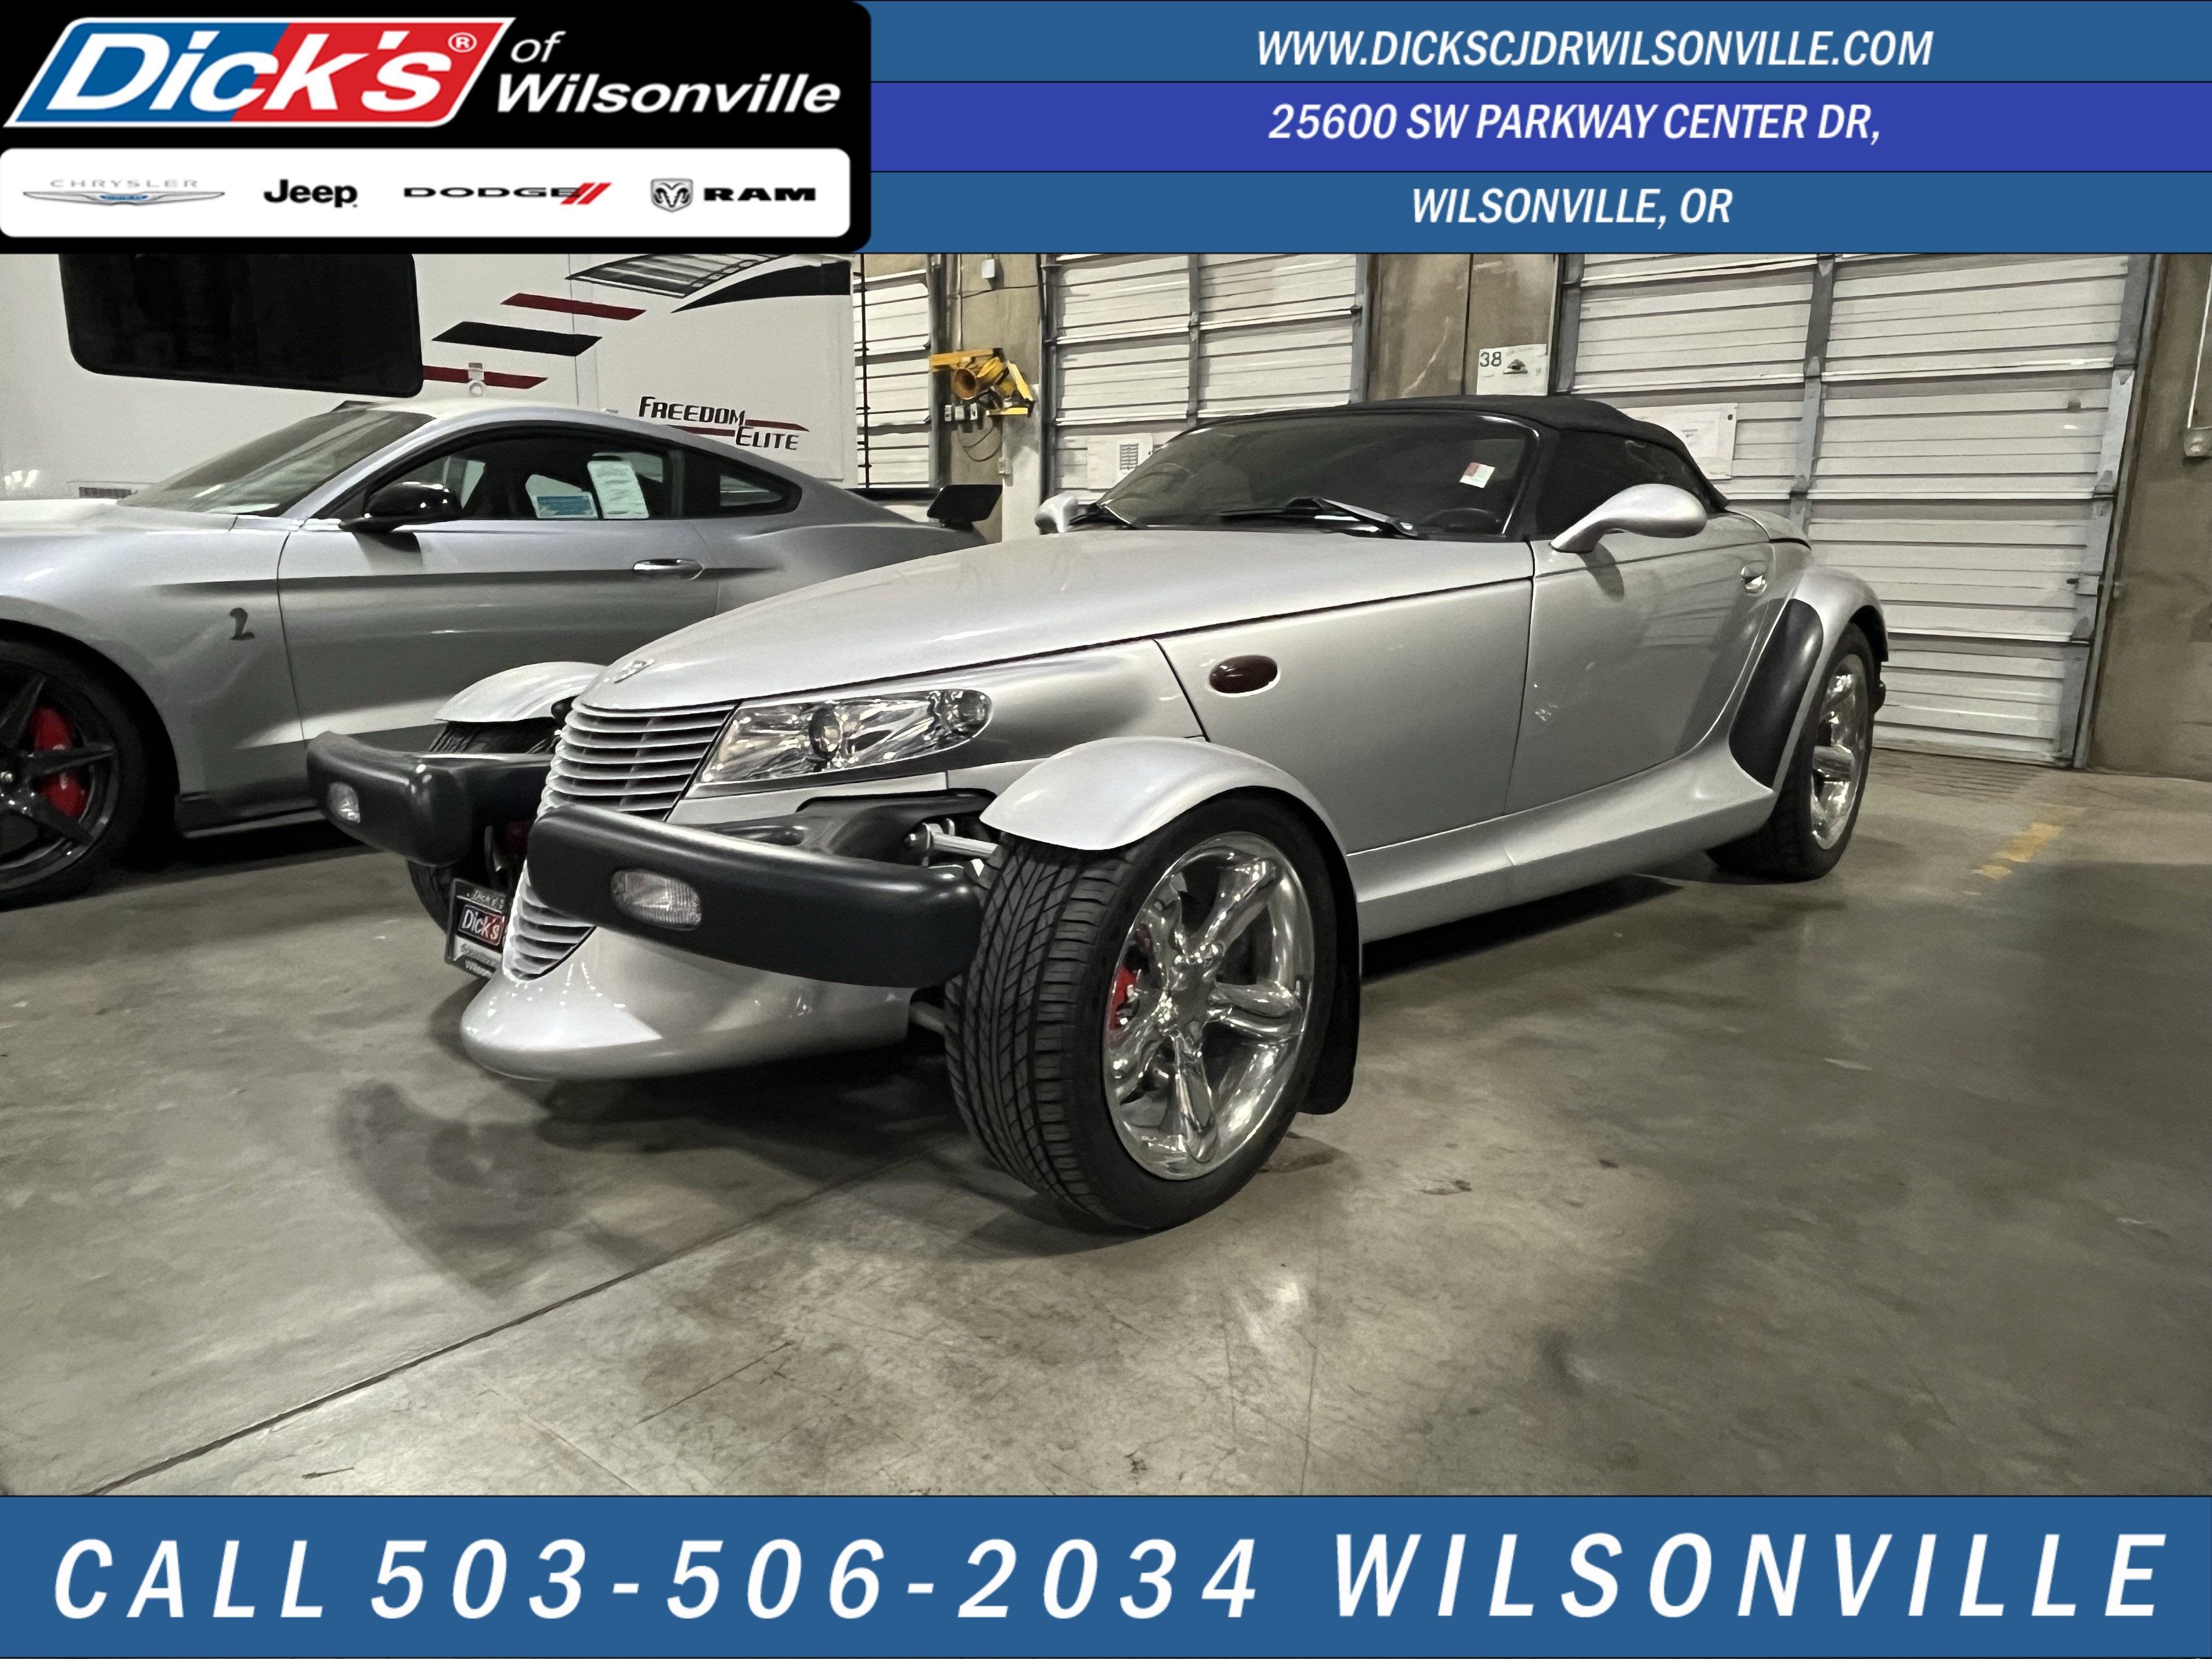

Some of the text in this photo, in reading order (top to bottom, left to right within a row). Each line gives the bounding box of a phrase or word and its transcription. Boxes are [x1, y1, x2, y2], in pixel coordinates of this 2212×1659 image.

[1480, 351, 1502, 367] 38
[639, 396, 746, 426] FREEDOM
[735, 425, 799, 450] ELITE
